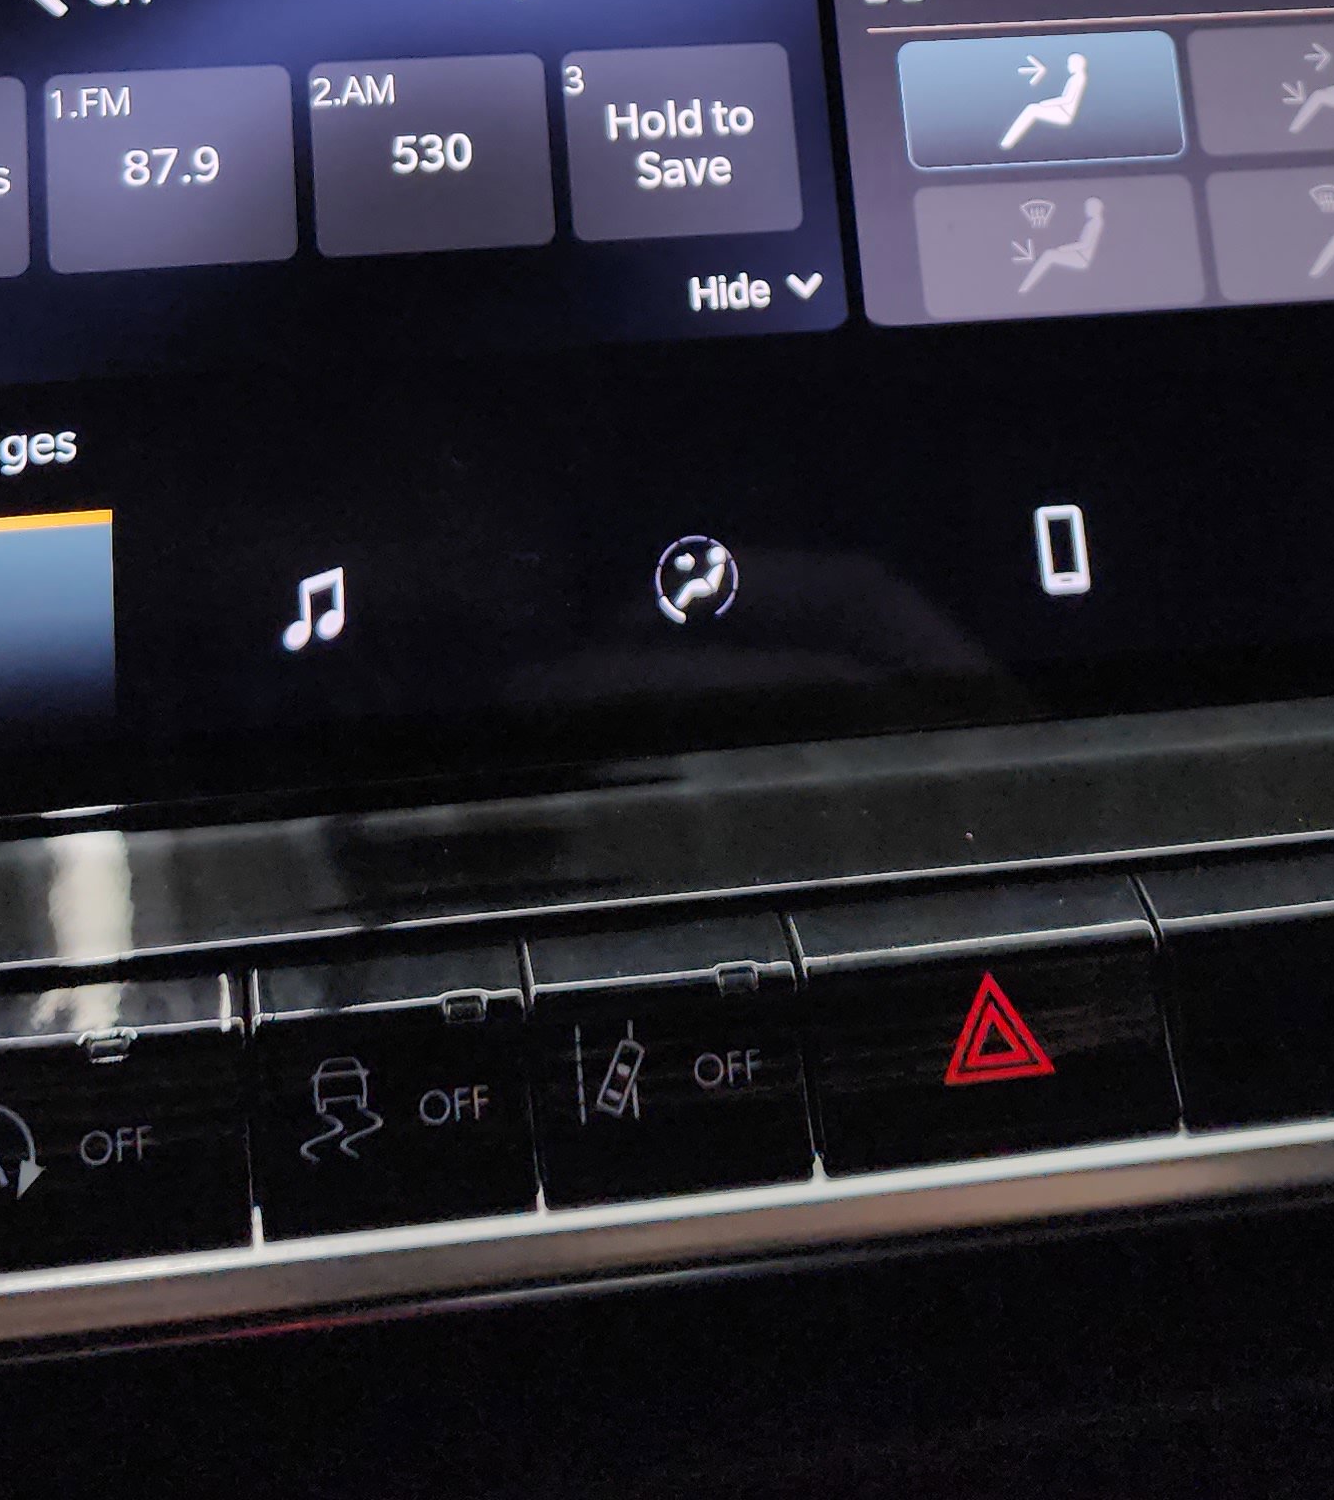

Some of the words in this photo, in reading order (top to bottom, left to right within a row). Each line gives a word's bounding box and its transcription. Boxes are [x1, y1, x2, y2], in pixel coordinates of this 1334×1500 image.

[563, 65, 586, 96] 3
[606, 98, 703, 141] Hold
[710, 100, 755, 135] to
[122, 146, 220, 187] 87.9
[392, 132, 473, 174] 530
[636, 150, 732, 188] Save
[689, 271, 772, 312] Hide
[692, 1049, 760, 1088] OFF
[419, 1084, 489, 1127] OFF
[78, 1124, 153, 1166] OFF
